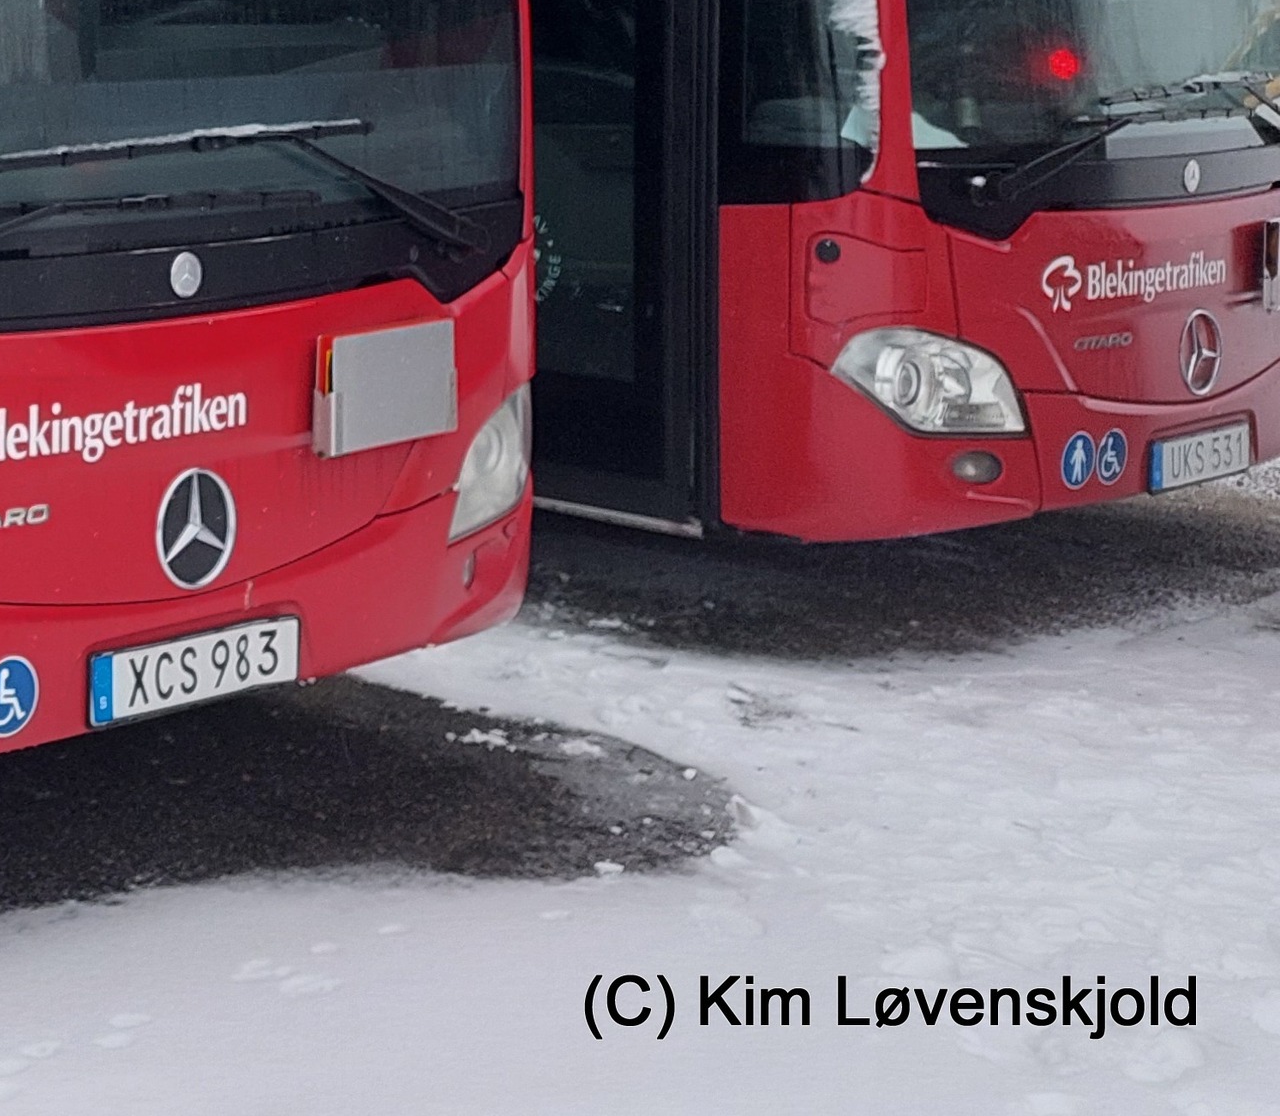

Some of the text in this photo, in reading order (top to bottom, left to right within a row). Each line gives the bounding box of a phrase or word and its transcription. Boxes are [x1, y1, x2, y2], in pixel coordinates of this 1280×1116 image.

[1087, 250, 1226, 303] Blekingetrafiken
[1074, 332, 1133, 351] CITARO
[1171, 432, 1243, 478] UKS 531
[128, 629, 279, 708] XCS 983
